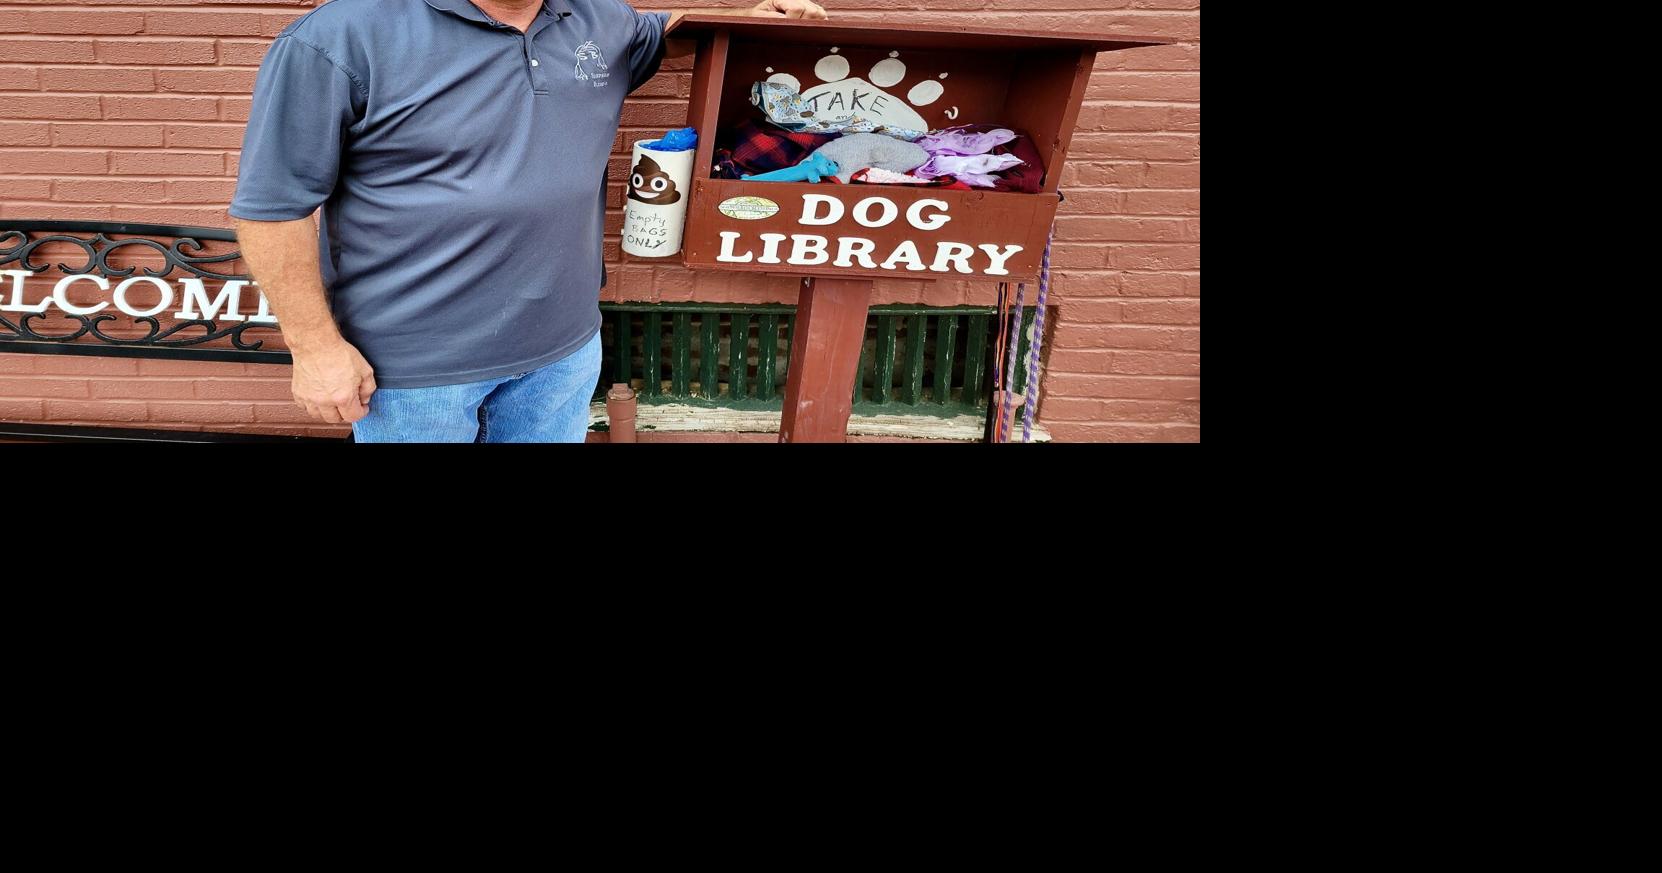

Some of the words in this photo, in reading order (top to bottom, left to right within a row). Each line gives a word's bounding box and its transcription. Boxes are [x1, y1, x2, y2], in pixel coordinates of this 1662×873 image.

[807, 89, 889, 116] TAKE
[629, 210, 666, 227] Empty
[798, 193, 951, 231] DOG
[627, 235, 667, 249] ONLY
[632, 224, 667, 237] BAGS
[716, 231, 1024, 275] LIBRARY
[0, 269, 278, 322] LCOM
